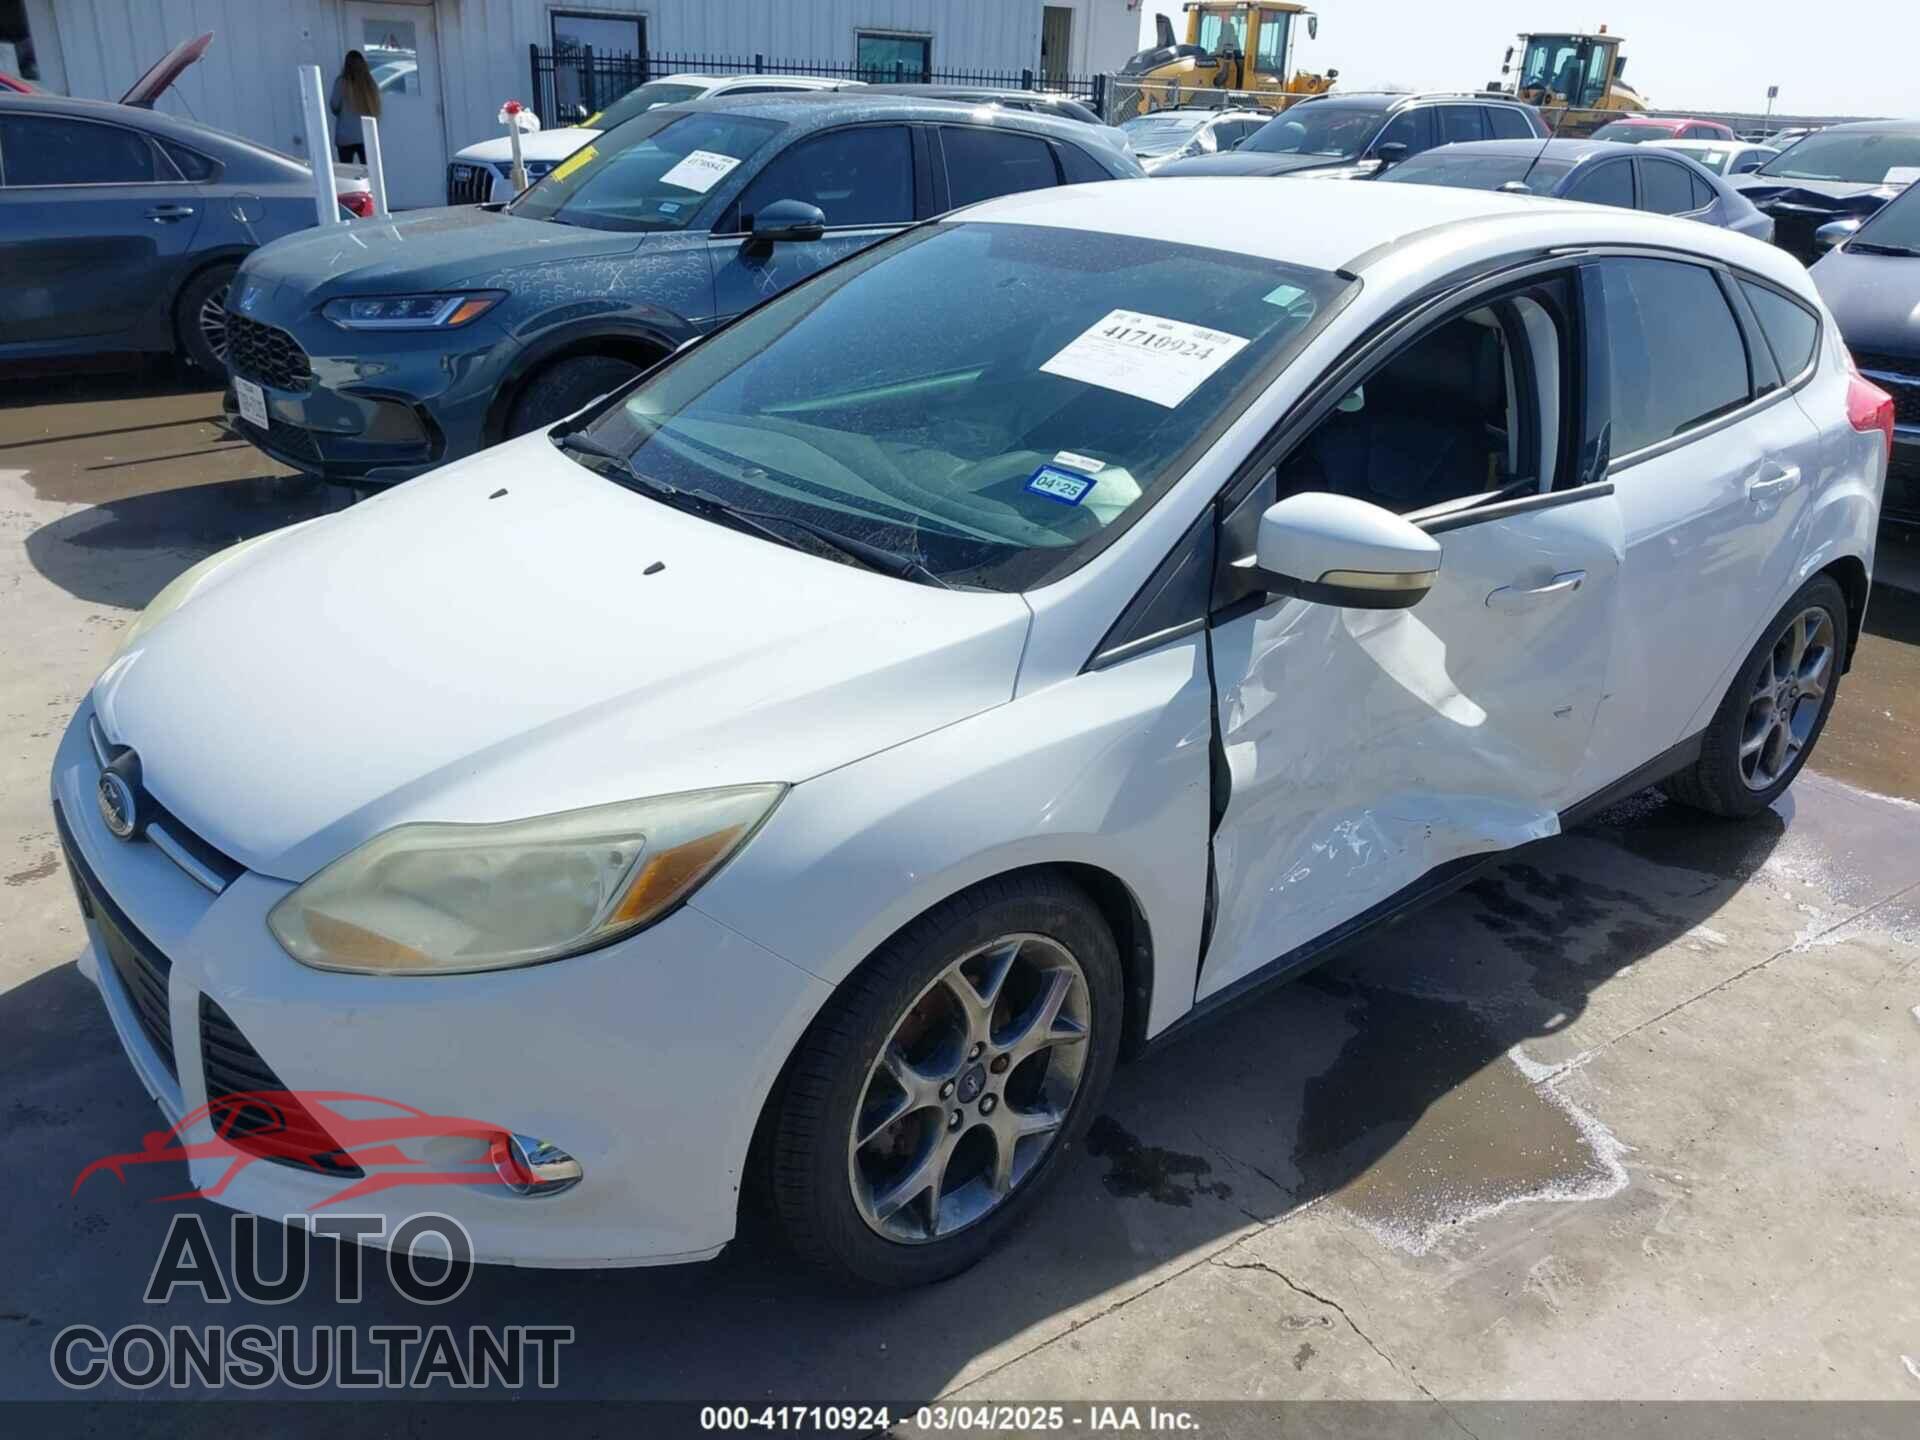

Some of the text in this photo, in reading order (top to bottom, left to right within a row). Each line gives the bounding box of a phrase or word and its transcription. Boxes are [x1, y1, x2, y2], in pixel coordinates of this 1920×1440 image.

[1103, 325, 1215, 360] 41710924
[1036, 476, 1056, 489] 04
[1060, 483, 1080, 496] 25
